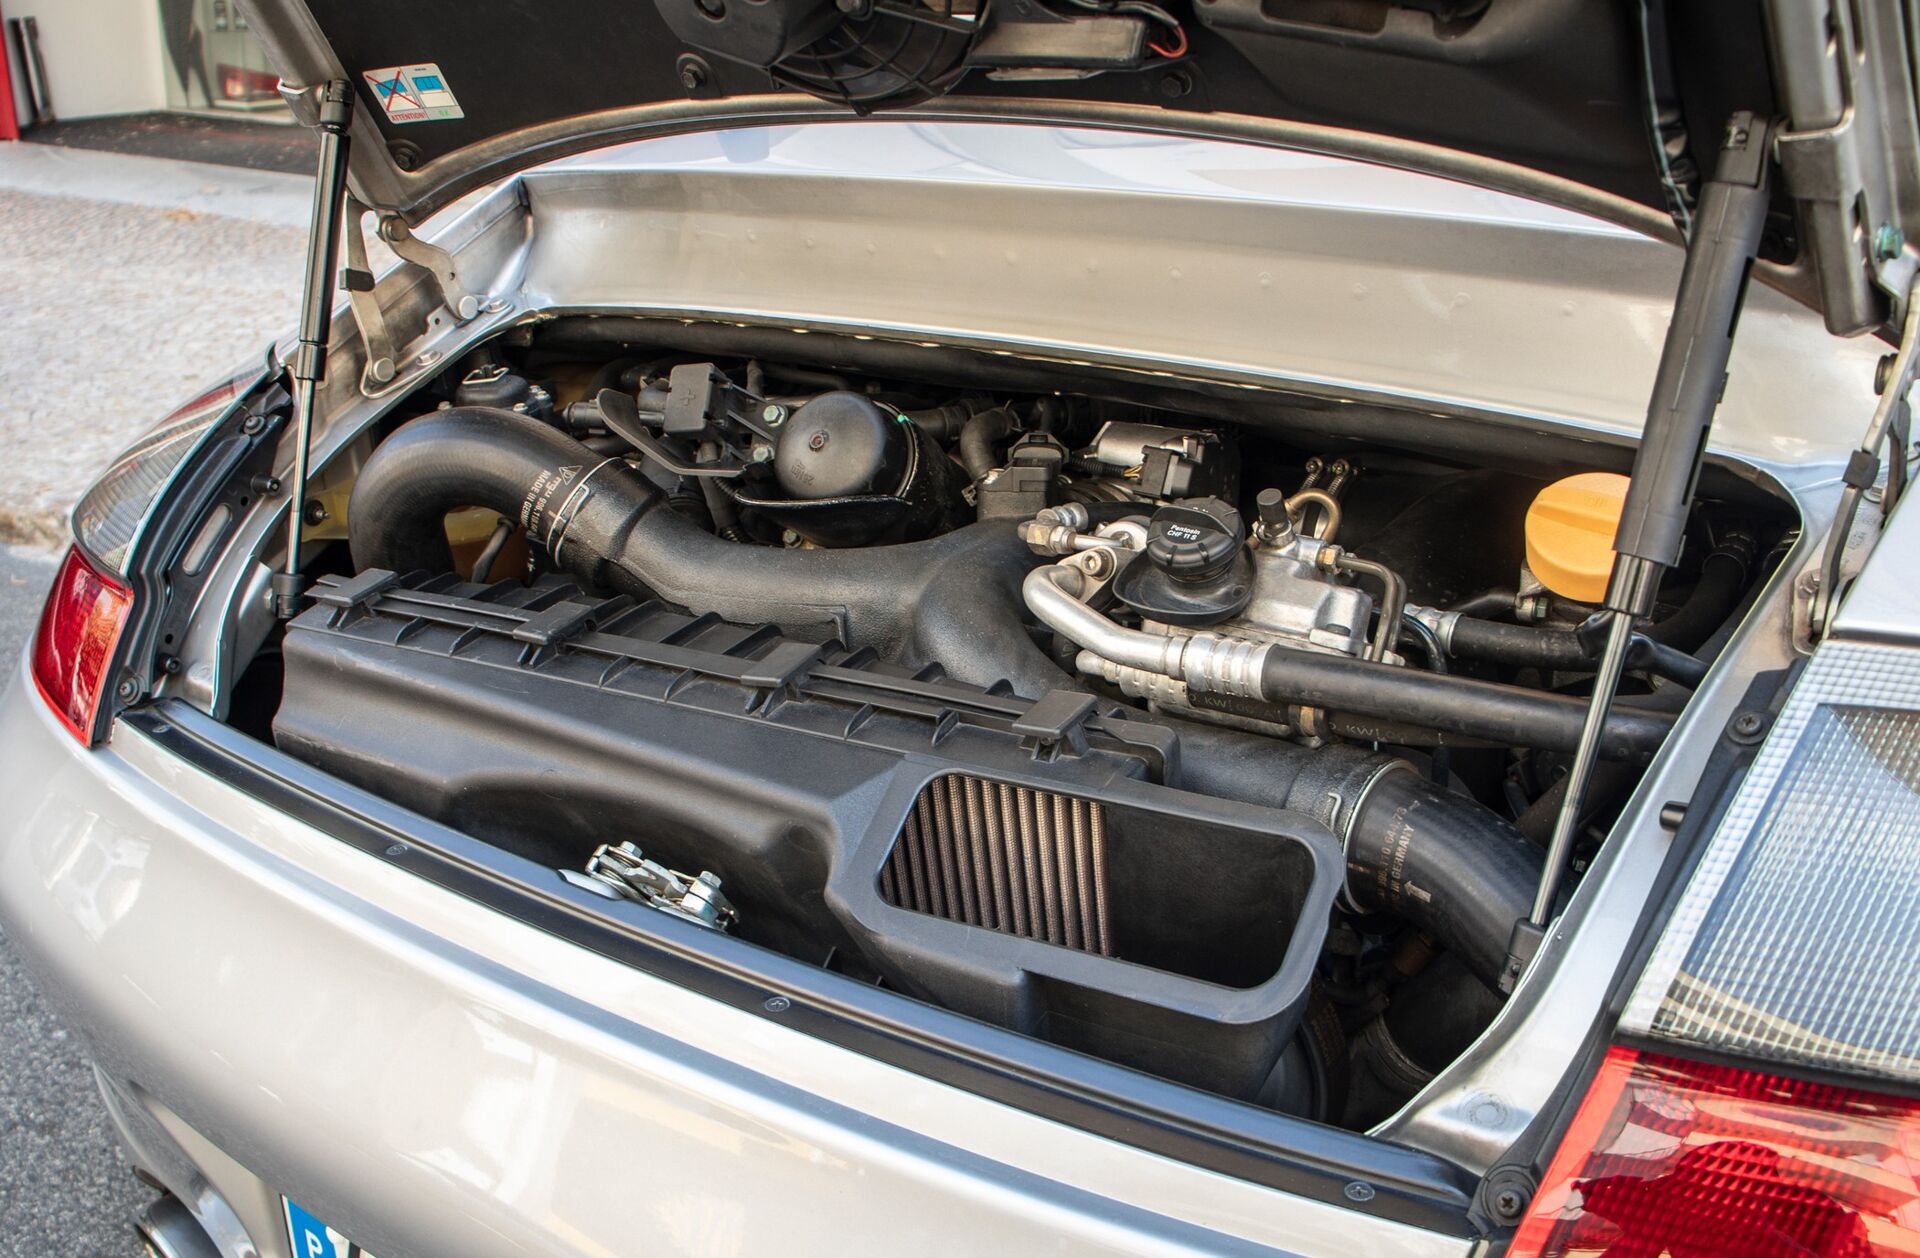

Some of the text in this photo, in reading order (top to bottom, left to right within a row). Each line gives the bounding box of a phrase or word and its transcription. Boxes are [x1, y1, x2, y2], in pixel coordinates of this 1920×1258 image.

[531, 470, 552, 493] MADE
[1167, 530, 1183, 538] CHF
[1171, 524, 1201, 536] Pentosin
[1391, 823, 1415, 879] GERMANY
[304, 1228, 323, 1258] P
